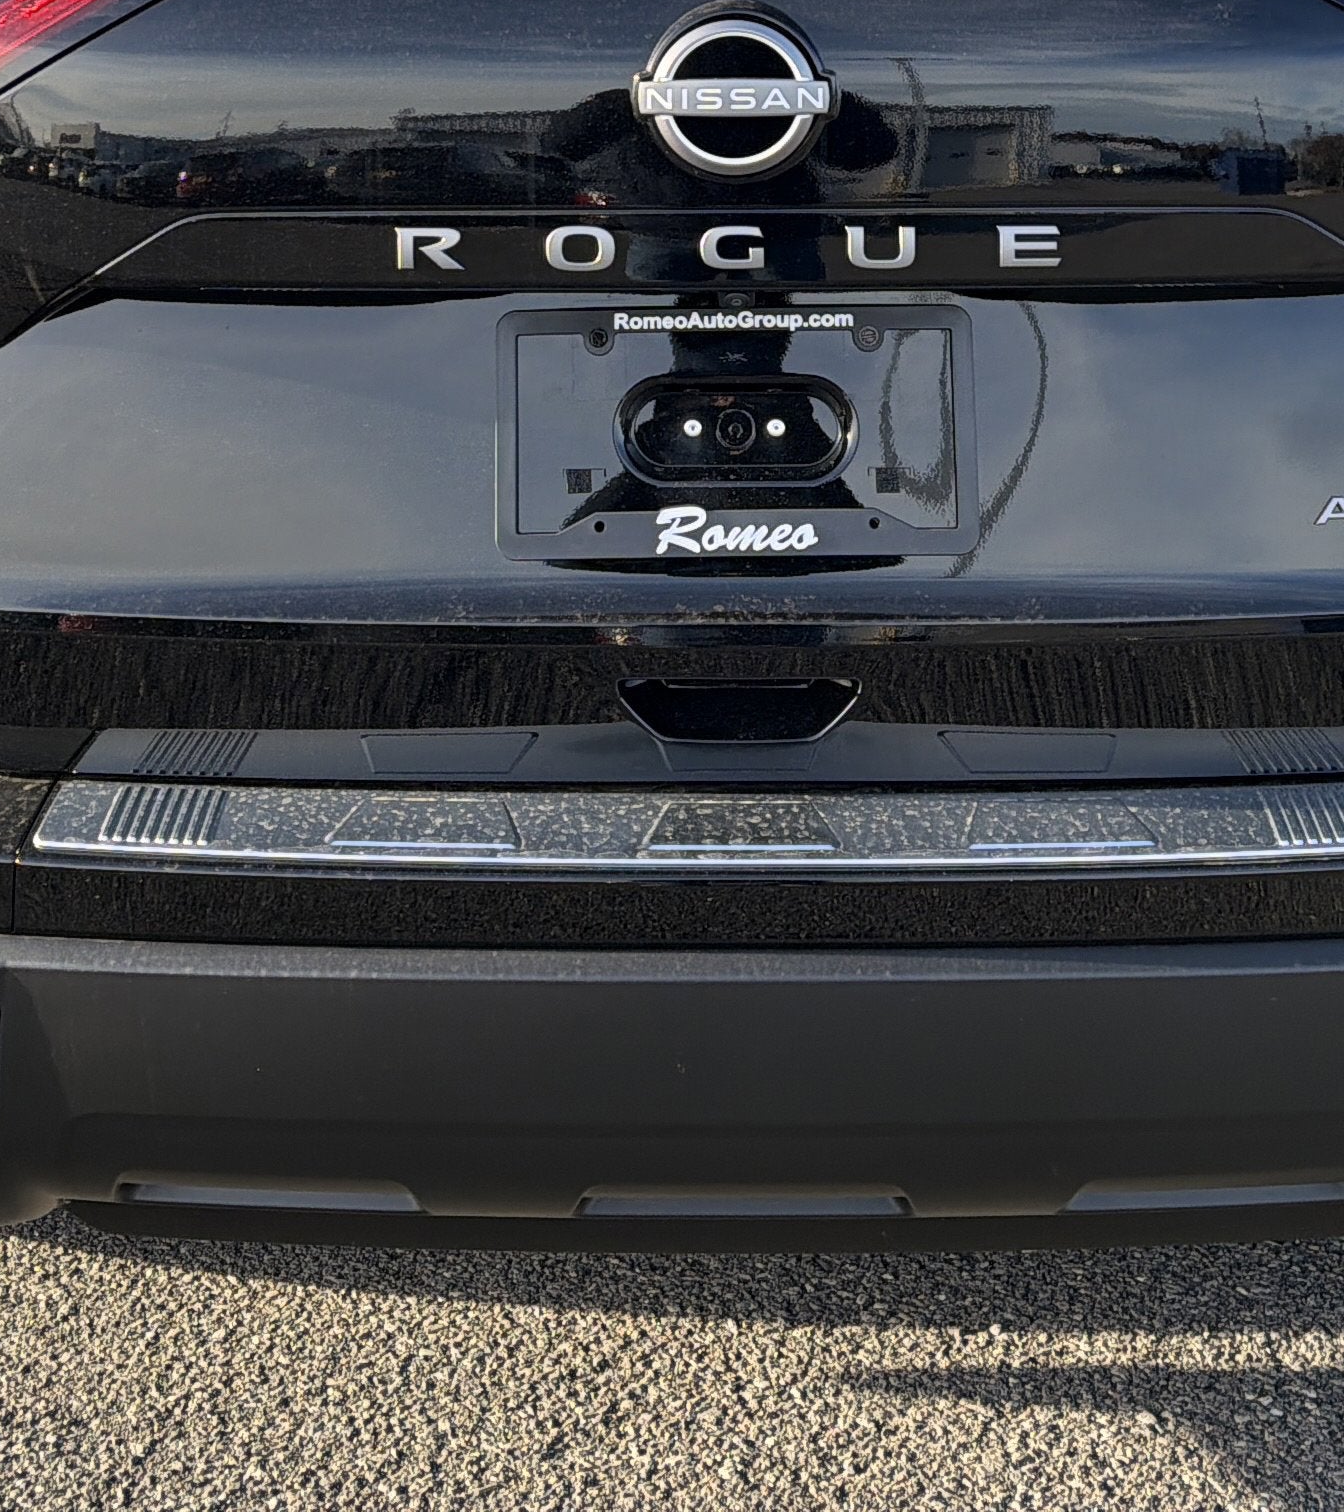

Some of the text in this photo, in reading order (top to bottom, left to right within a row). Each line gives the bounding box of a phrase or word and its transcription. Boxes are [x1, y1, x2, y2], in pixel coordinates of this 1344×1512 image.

[646, 87, 824, 110] NISSAN
[394, 225, 1062, 271] ROGUE
[613, 311, 854, 331] RomeoAutoGroup.com
[656, 506, 819, 554] Romeo
